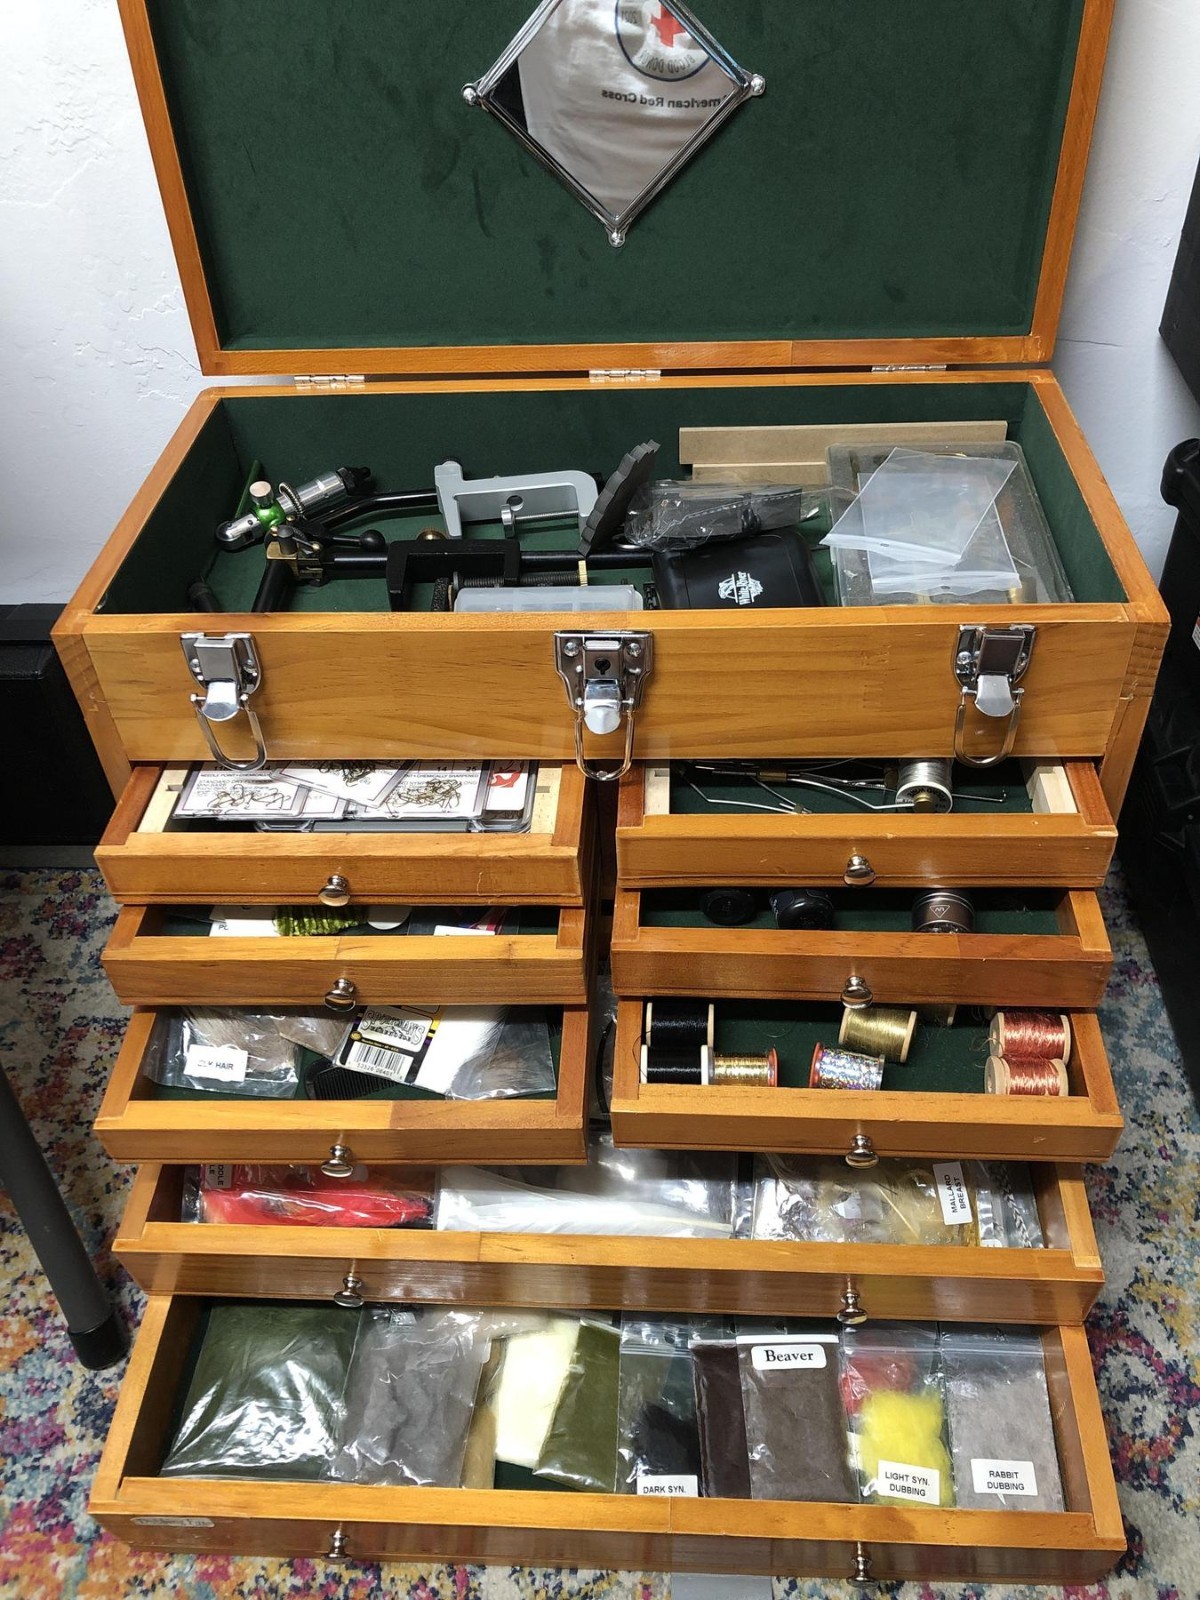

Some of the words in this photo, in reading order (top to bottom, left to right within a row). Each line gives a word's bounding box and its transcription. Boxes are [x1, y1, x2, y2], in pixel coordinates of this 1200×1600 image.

[944, 1174, 958, 1213] MALLARD
[953, 1177, 966, 1210] BREAST
[764, 1349, 814, 1363] Beaver
[884, 1471, 910, 1482] LIGHT
[911, 1476, 931, 1486] SYN.
[988, 1470, 1020, 1479] RABBIT
[643, 1485, 666, 1494] DARK
[667, 1485, 687, 1494] SYN.
[889, 1483, 927, 1497] DUBBING
[986, 1481, 1025, 1491] DUBBING
